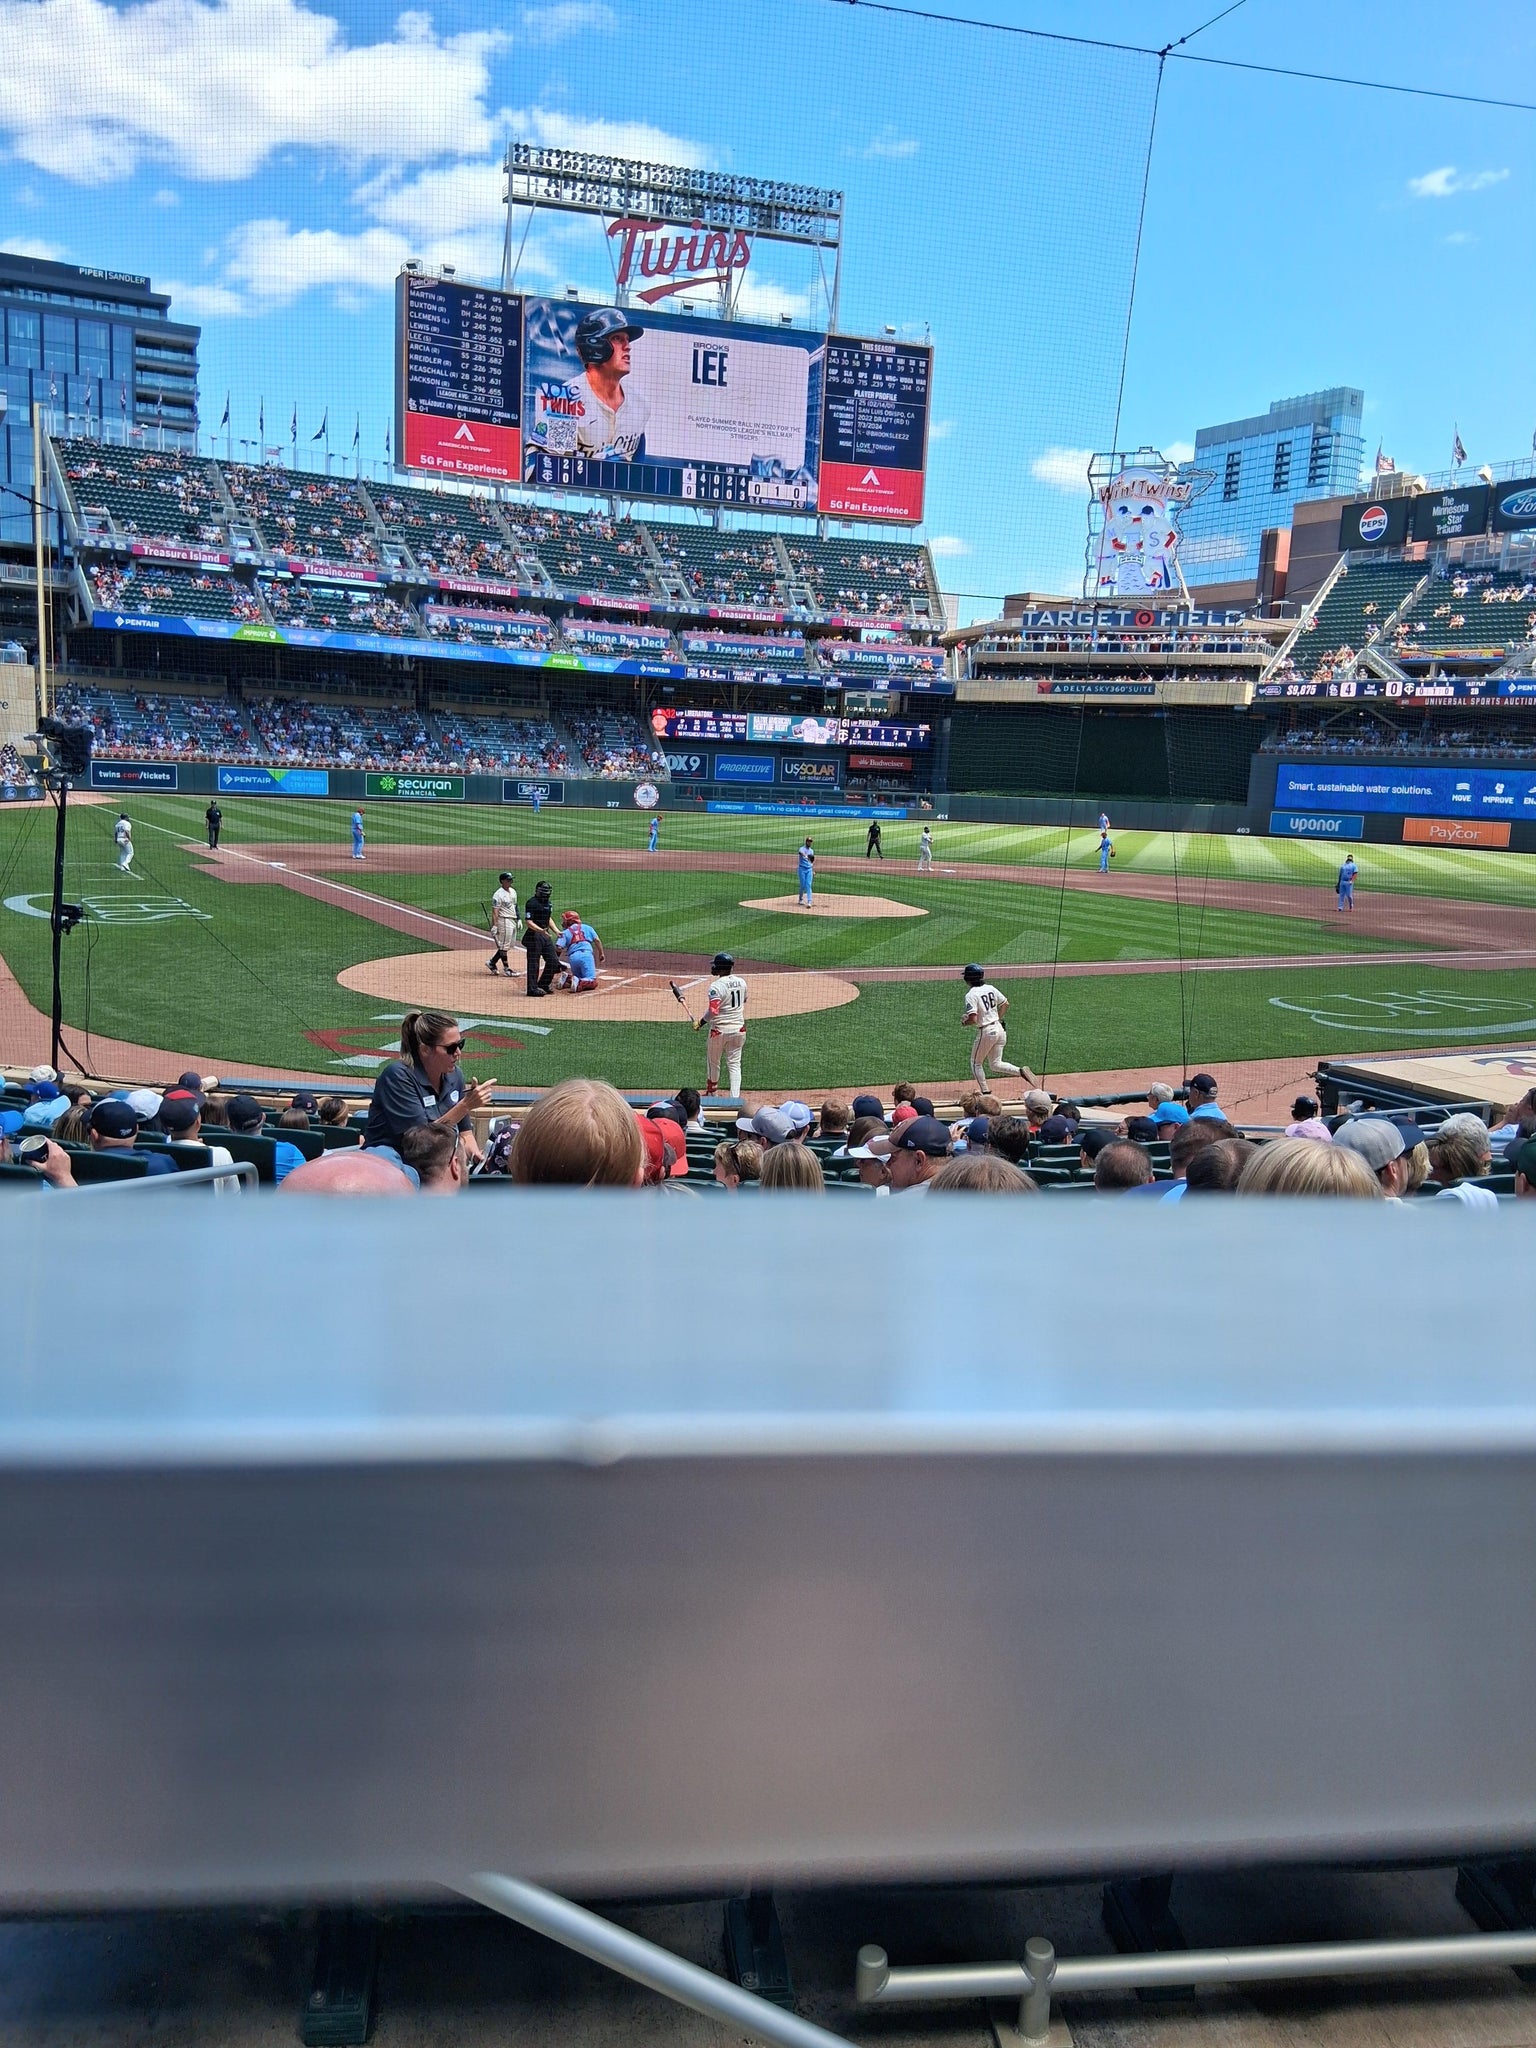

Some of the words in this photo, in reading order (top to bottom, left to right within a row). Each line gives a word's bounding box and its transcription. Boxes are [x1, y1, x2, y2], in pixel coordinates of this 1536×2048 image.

[608, 218, 750, 284] Twins
[79, 267, 103, 278] PIPER
[109, 272, 146, 285] SANDLER
[410, 291, 435, 301] MARTIN
[410, 301, 436, 311] BUXTON
[410, 311, 440, 322] CLEMENS
[410, 322, 430, 331] LEWIS
[410, 332, 422, 340] LEE
[409, 343, 430, 352] ARCIA
[694, 342, 729, 352] BROOKS
[875, 344, 896, 353] SEASON
[409, 354, 442, 365] KREIDLER
[409, 364, 448, 377] KEASCHALL
[692, 349, 728, 387] LEE
[409, 375, 441, 386] JACKSON
[854, 390, 874, 399] PLAYER
[875, 392, 897, 401] PROFILE
[541, 396, 585, 417] TWINS
[688, 415, 710, 423] PLAYED
[711, 417, 737, 426] SUMMER
[738, 420, 752, 428] BALL
[874, 416, 893, 424] DRAFT
[695, 423, 737, 432] NORTHWOODS
[738, 427, 766, 436] LEAGUE'S
[872, 443, 895, 451] TONIGHT
[420, 455, 434, 465] 5G
[436, 457, 454, 468] Fan
[456, 460, 508, 475] Experience
[687, 472, 692, 481] 4
[700, 473, 706, 483] 4
[714, 475, 719, 484] 0
[727, 476, 732, 486] 2
[563, 473, 568, 483] 0
[686, 486, 691, 495] 0
[714, 489, 719, 498] 0
[727, 490, 732, 500] 0
[755, 484, 760, 495] 0
[775, 486, 779, 496] 1
[794, 488, 799, 499] 0
[1099, 480, 1136, 502] Win!
[1139, 478, 1192, 497] Twins!
[1442, 496, 1454, 505] The
[830, 500, 843, 509] 5G
[845, 501, 860, 511] Fan
[862, 503, 909, 515] Experience
[1432, 502, 1468, 517] Minnesota
[1361, 520, 1386, 528] PEPSI
[1447, 514, 1464, 525] Star
[1436, 523, 1462, 535] Tribune
[143, 546, 187, 560] Treasure
[190, 551, 220, 563] Island
[448, 581, 484, 593] Treasure
[486, 585, 511, 596] Island
[717, 610, 751, 620] Treasure
[753, 613, 776, 621] Island
[1023, 610, 1131, 626] TARGET
[1161, 611, 1246, 626] FIELD
[587, 631, 617, 645] Home
[641, 636, 666, 649] Deck
[125, 619, 159, 628] PENTAIR
[244, 629, 268, 638] IMPROVE
[647, 666, 670, 674] PENTAIR
[855, 652, 883, 662] Home
[886, 654, 905, 664] Run
[700, 670, 717, 678] 94.5
[1345, 682, 1351, 693] 4
[1391, 683, 1397, 695] 0
[1471, 697, 1500, 705] SPORTS
[666, 709, 676, 718] 32
[690, 755, 700, 771] 9
[719, 764, 772, 773] PROGRESSIVE
[99, 770, 170, 780] twins.com/tickets
[398, 778, 451, 790] securian
[1317, 783, 1364, 793] sustainable
[1366, 785, 1390, 794] water
[1392, 784, 1432, 795] solutions.
[1483, 796, 1514, 804] IMPROVE
[1290, 818, 1342, 832] uponor
[1430, 826, 1482, 840] Paycor
[731, 990, 740, 1007] 11
